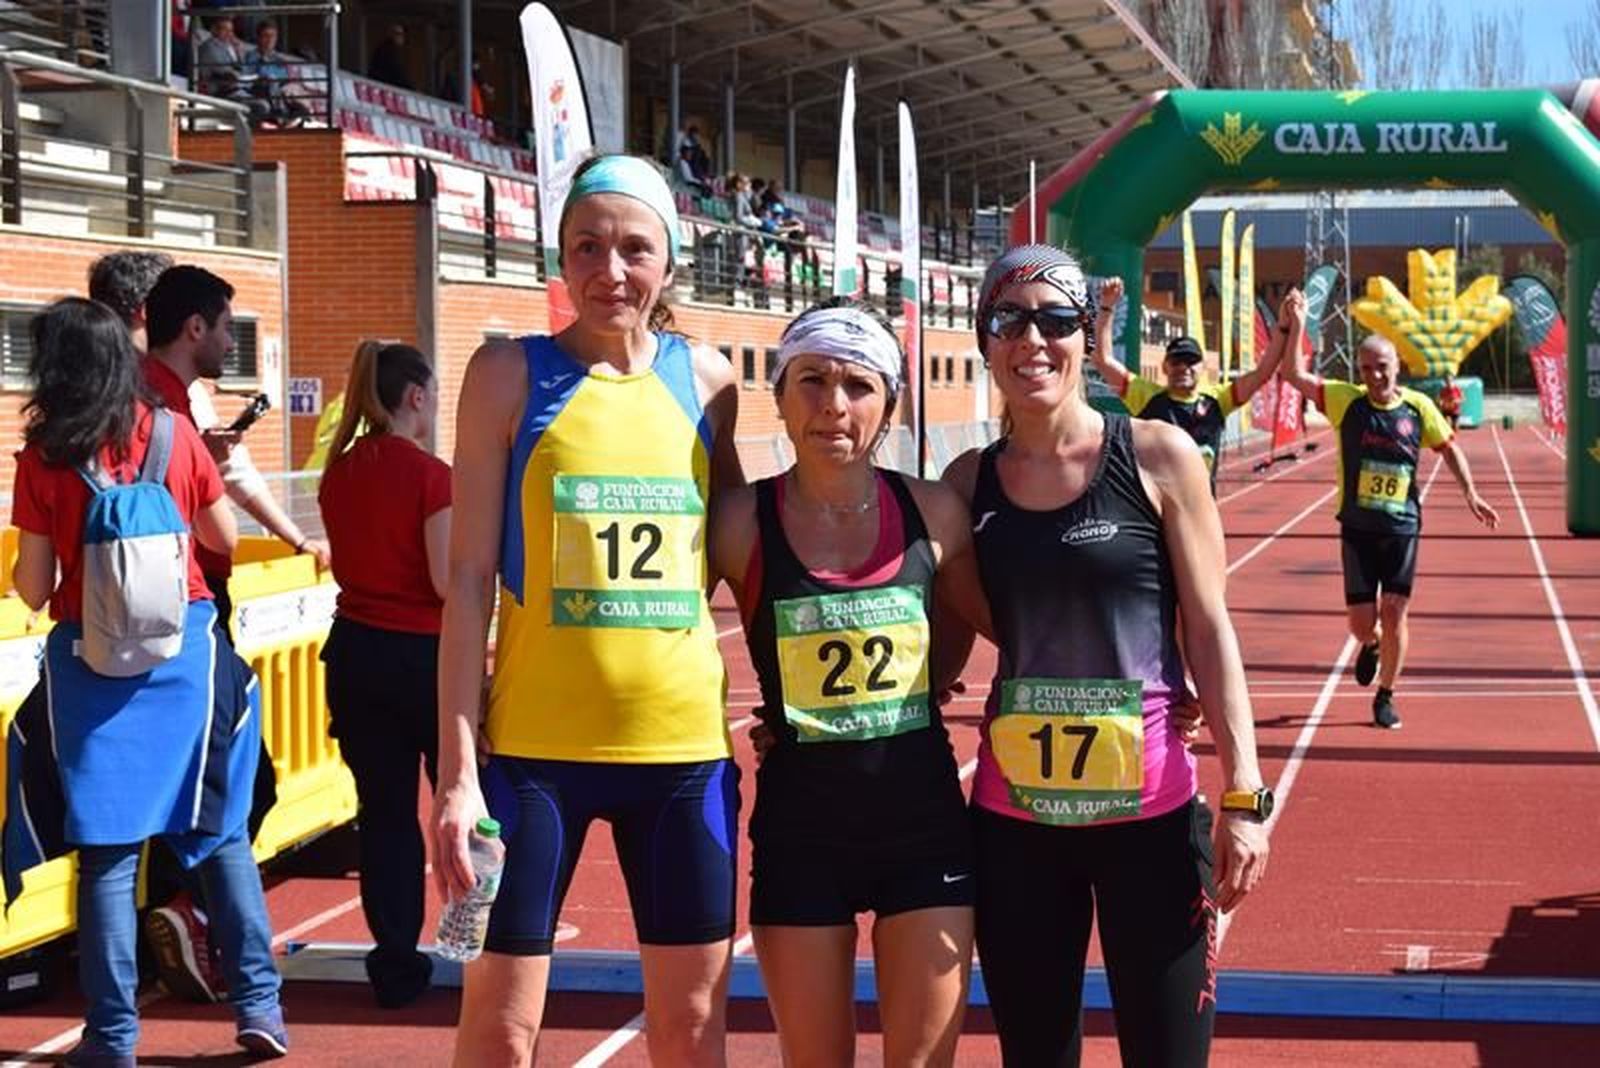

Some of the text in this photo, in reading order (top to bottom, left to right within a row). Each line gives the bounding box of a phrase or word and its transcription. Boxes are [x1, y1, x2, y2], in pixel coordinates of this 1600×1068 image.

[1274, 121, 1508, 155] CAJA RURAL
[1370, 475, 1398, 497] 36
[603, 497, 686, 511] CAJA RURAL
[596, 521, 663, 580] 12
[599, 601, 692, 616] CAJA RURAL
[823, 607, 910, 629] CAJA RURAL
[818, 635, 897, 697] 22
[1034, 699, 1120, 714] CAJA RURAL
[832, 705, 922, 731] CAJA RURAL
[1029, 723, 1099, 780] 17
[1032, 799, 1074, 815] CAJA
